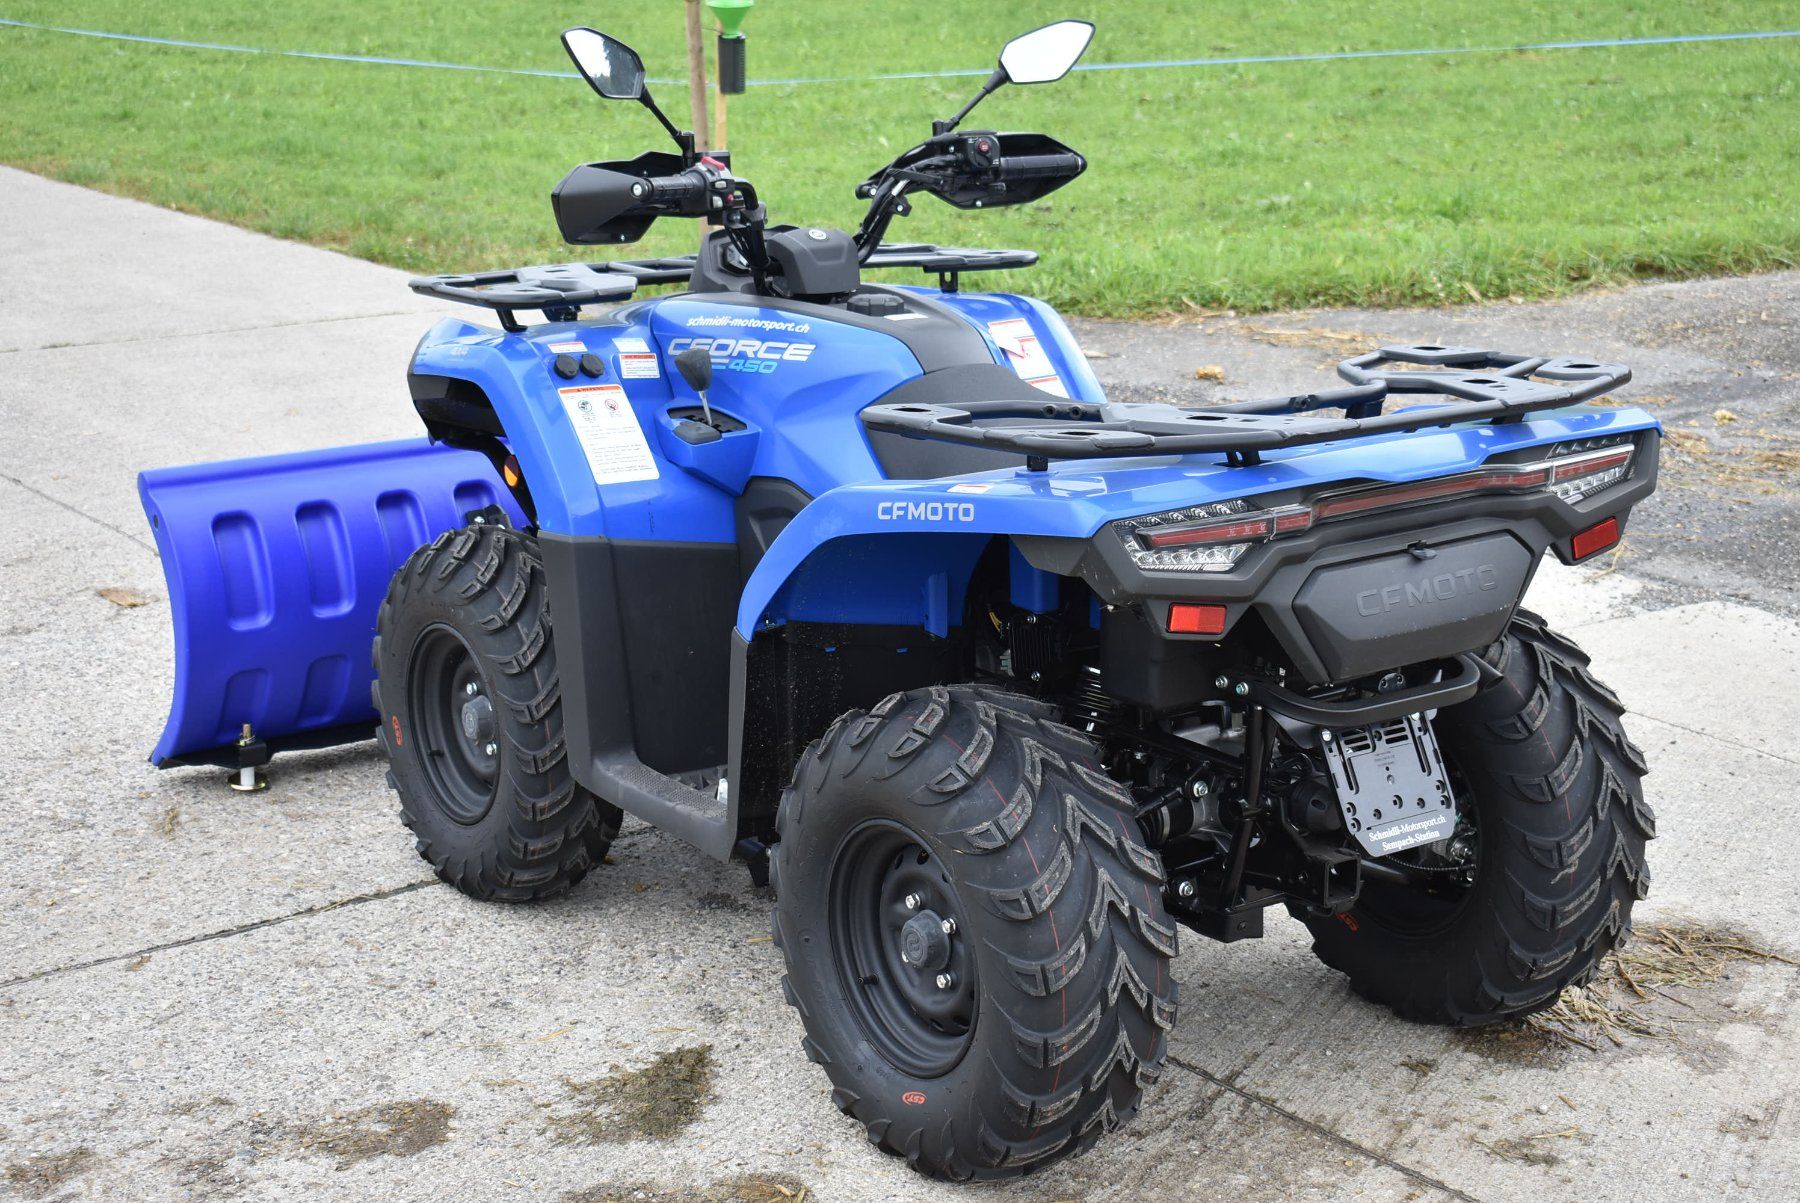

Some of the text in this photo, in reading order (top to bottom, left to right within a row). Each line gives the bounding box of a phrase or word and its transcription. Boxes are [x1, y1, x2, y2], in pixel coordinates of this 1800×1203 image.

[686, 315, 811, 334] schmidli-motorsport.ch
[728, 359, 778, 374] 450
[877, 502, 975, 522] CFMOTO
[1356, 563, 1498, 617] CFMOTO
[1368, 814, 1447, 842] Schmidli-Motorsport.ch
[1381, 829, 1441, 851] Sempach-Station
